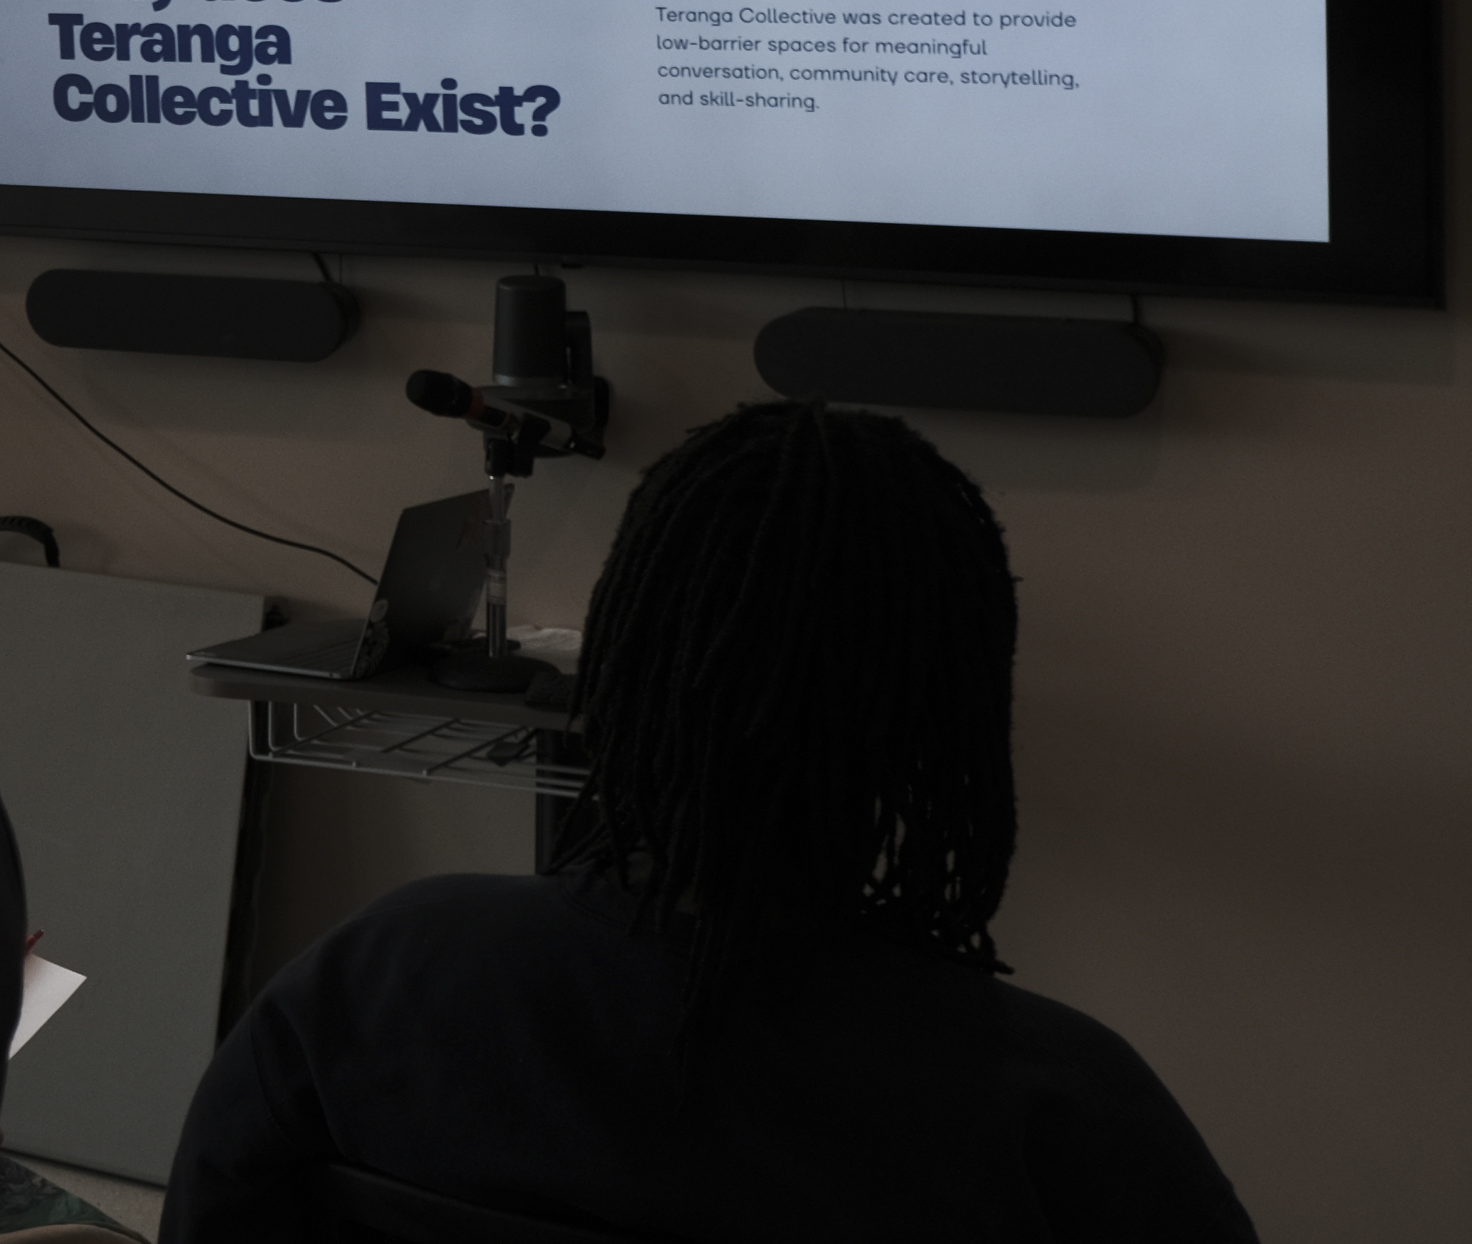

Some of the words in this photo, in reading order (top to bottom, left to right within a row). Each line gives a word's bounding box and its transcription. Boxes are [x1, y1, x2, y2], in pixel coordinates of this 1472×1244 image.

[655, 6, 734, 27] Teranga
[738, 7, 837, 25] Collective
[842, 12, 883, 26] was
[887, 10, 967, 27] created
[972, 12, 994, 27] to
[999, 11, 1077, 30] provide
[48, 13, 291, 75] Teranga
[656, 34, 762, 52] low-barrier
[767, 39, 837, 55] spaces
[842, 37, 870, 54] for
[875, 39, 988, 60] meaningful
[657, 64, 784, 81] conversation,
[789, 66, 898, 87] community
[903, 70, 954, 86] care,
[959, 69, 1080, 91] storytelling,
[54, 74, 347, 129] Collective
[366, 78, 560, 136] Exist?
[658, 90, 694, 106] and
[699, 90, 819, 113] skill-sharing.
